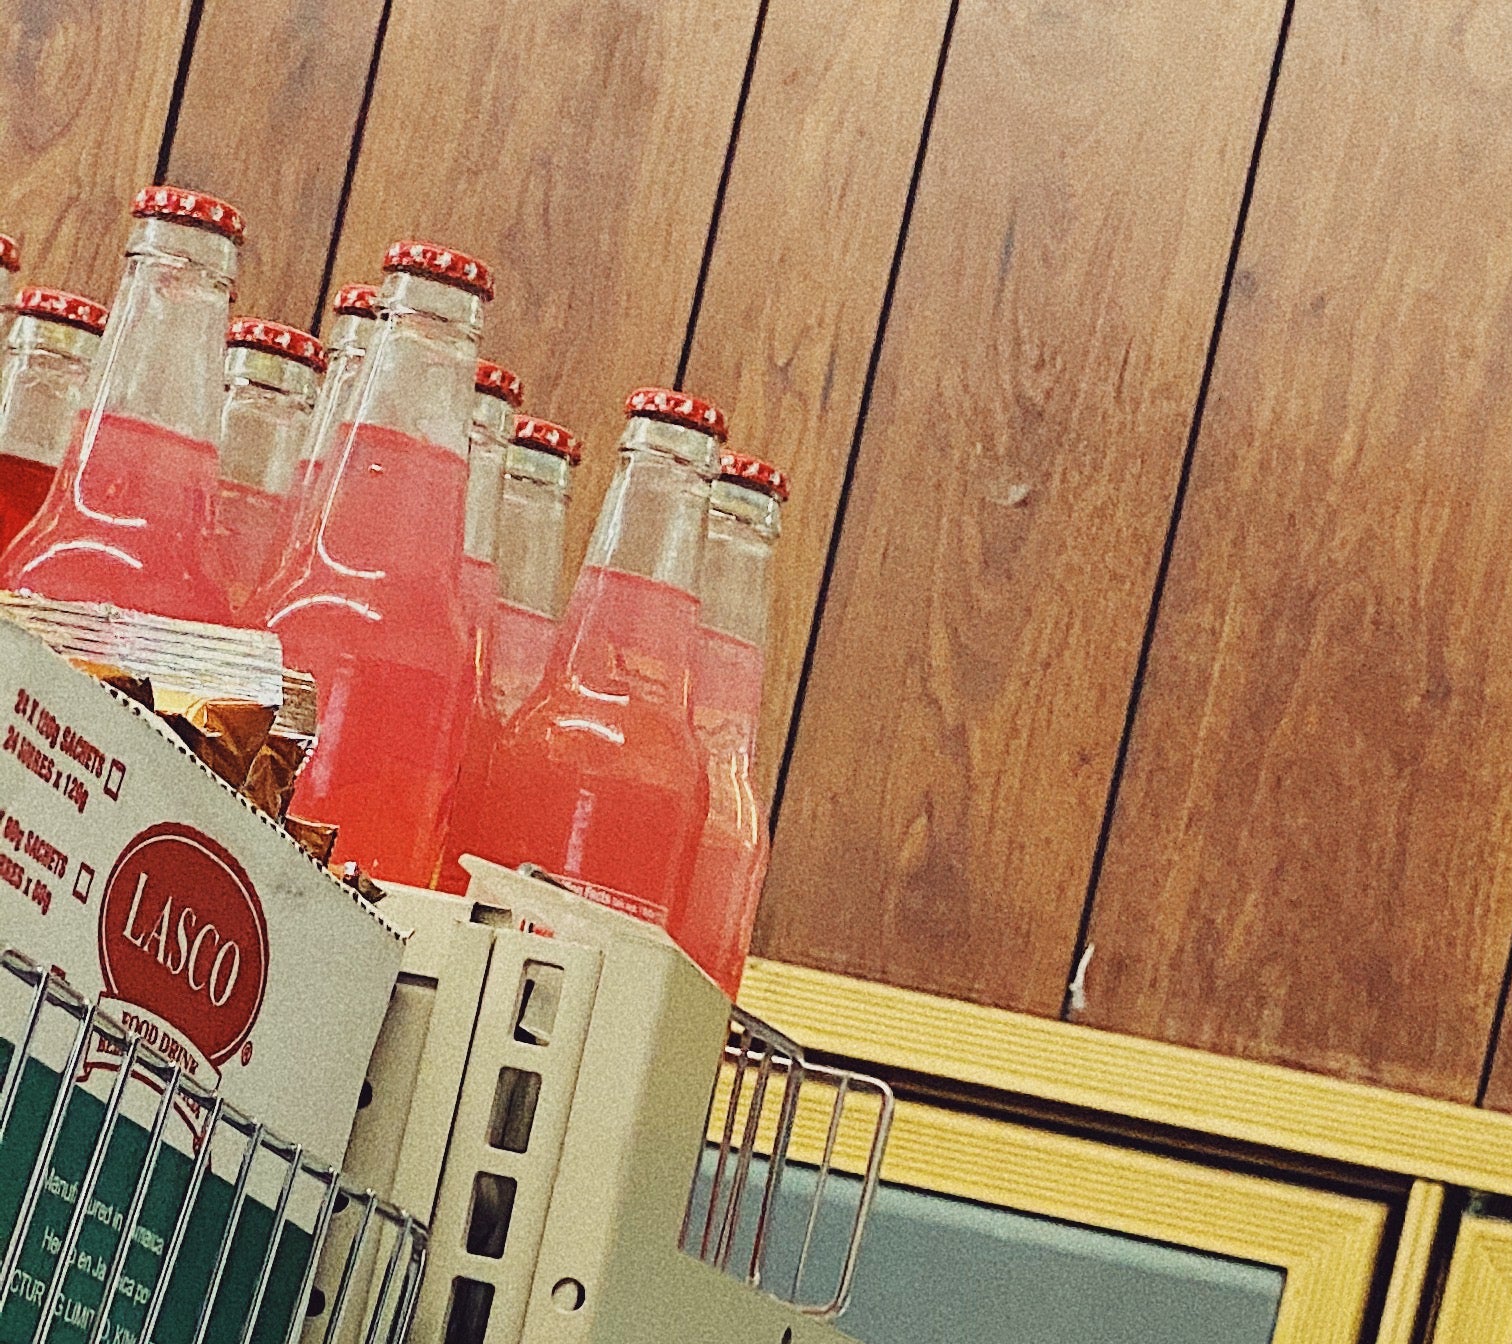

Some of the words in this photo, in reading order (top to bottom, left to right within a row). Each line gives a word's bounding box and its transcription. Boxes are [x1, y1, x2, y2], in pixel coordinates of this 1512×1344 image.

[3, 725, 20, 754] 24
[63, 773, 89, 814] 120g
[59, 726, 106, 779] SACHETS
[24, 830, 69, 880] SACHETS
[121, 871, 241, 1007] LASCO
[121, 1010, 159, 1046] FOOD
[159, 1031, 200, 1075] DRINK
[44, 1167, 114, 1225] Manufured
[111, 1206, 124, 1232] in
[77, 1251, 93, 1274] en
[91, 1256, 136, 1297] Jaica
